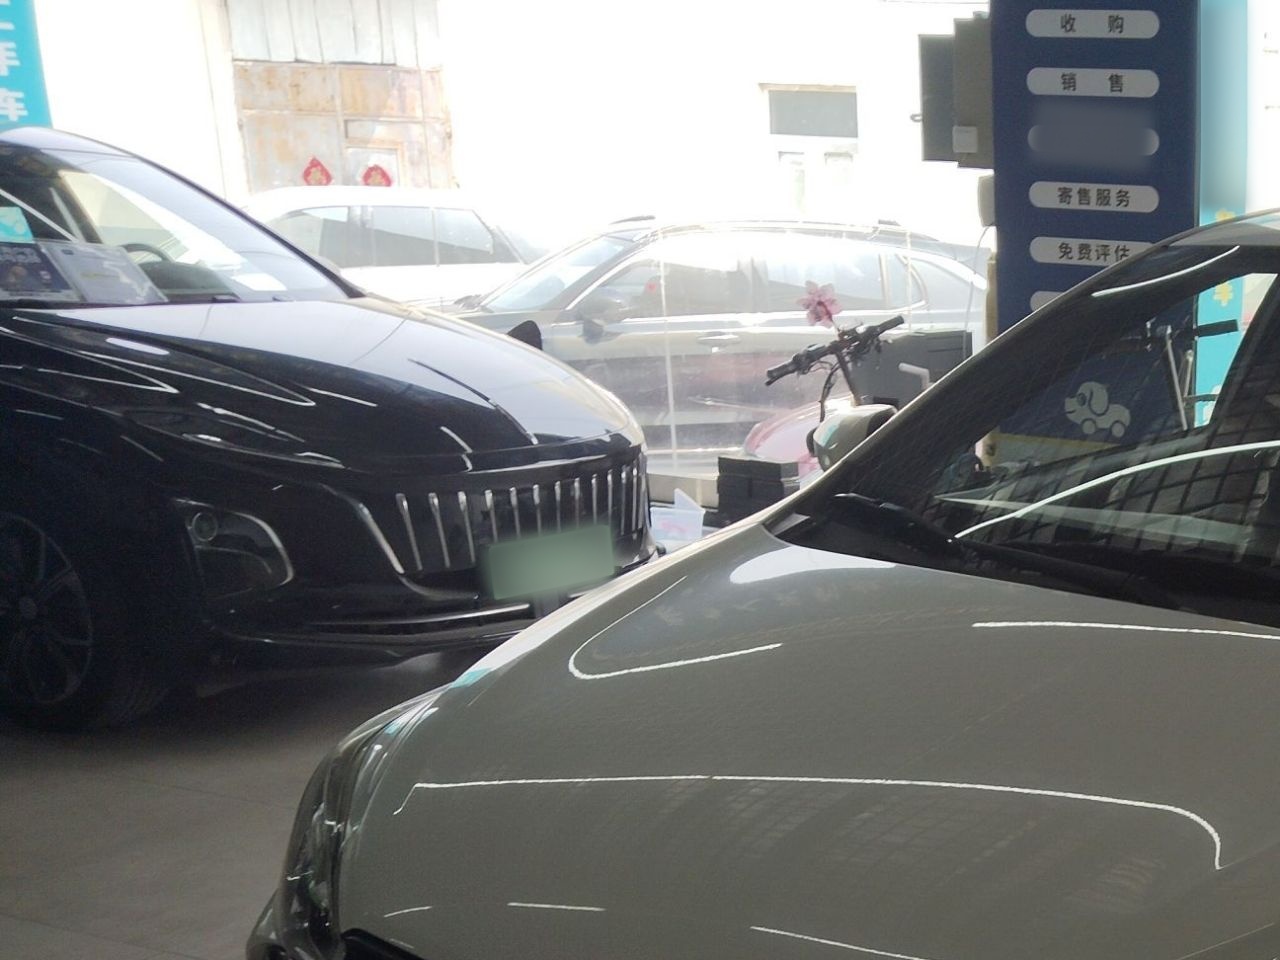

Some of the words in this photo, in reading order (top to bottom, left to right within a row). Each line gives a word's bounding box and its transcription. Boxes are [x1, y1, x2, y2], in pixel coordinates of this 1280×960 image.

[1060, 13, 1125, 34] 收购
[1060, 72, 1124, 93] 销售
[1057, 186, 1132, 208] 寄售服务
[1058, 242, 1130, 262] 免费评估
